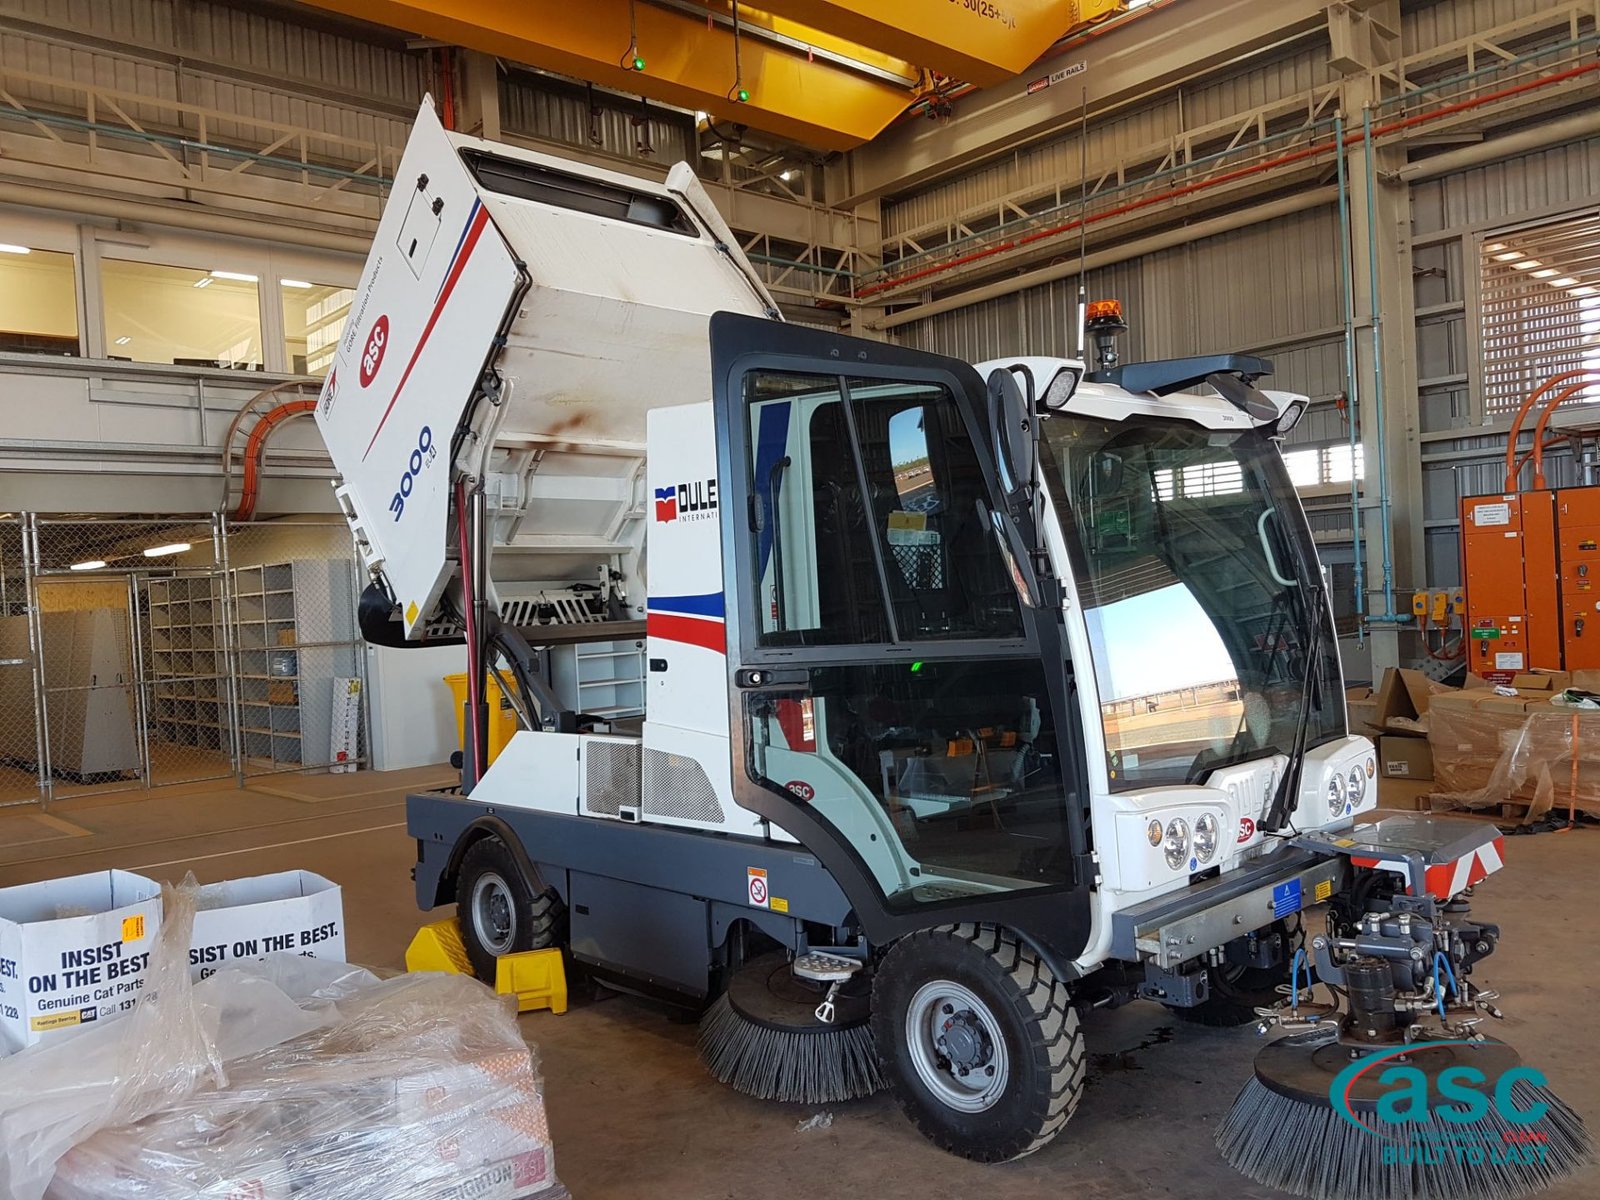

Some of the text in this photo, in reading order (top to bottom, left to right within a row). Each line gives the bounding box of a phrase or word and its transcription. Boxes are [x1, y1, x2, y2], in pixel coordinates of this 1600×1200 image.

[1051, 72, 1065, 82] LIVE
[1066, 63, 1085, 76] RAILS
[354, 293, 370, 329] Filtration
[367, 255, 383, 293] Products
[363, 326, 385, 376] asc
[388, 425, 432, 523] 3000
[678, 478, 717, 513] DULE
[679, 511, 718, 523] INTERNATI
[61, 940, 124, 969] INSIST
[189, 921, 338, 965] SIST ON THE BEST.
[0, 957, 18, 980] EST.
[28, 973, 57, 993] ON
[62, 967, 102, 989] THE
[37, 993, 91, 1011] Genuine
[116, 978, 145, 995] Parts
[81, 1008, 97, 1020] CAT
[99, 1004, 117, 1018] Call
